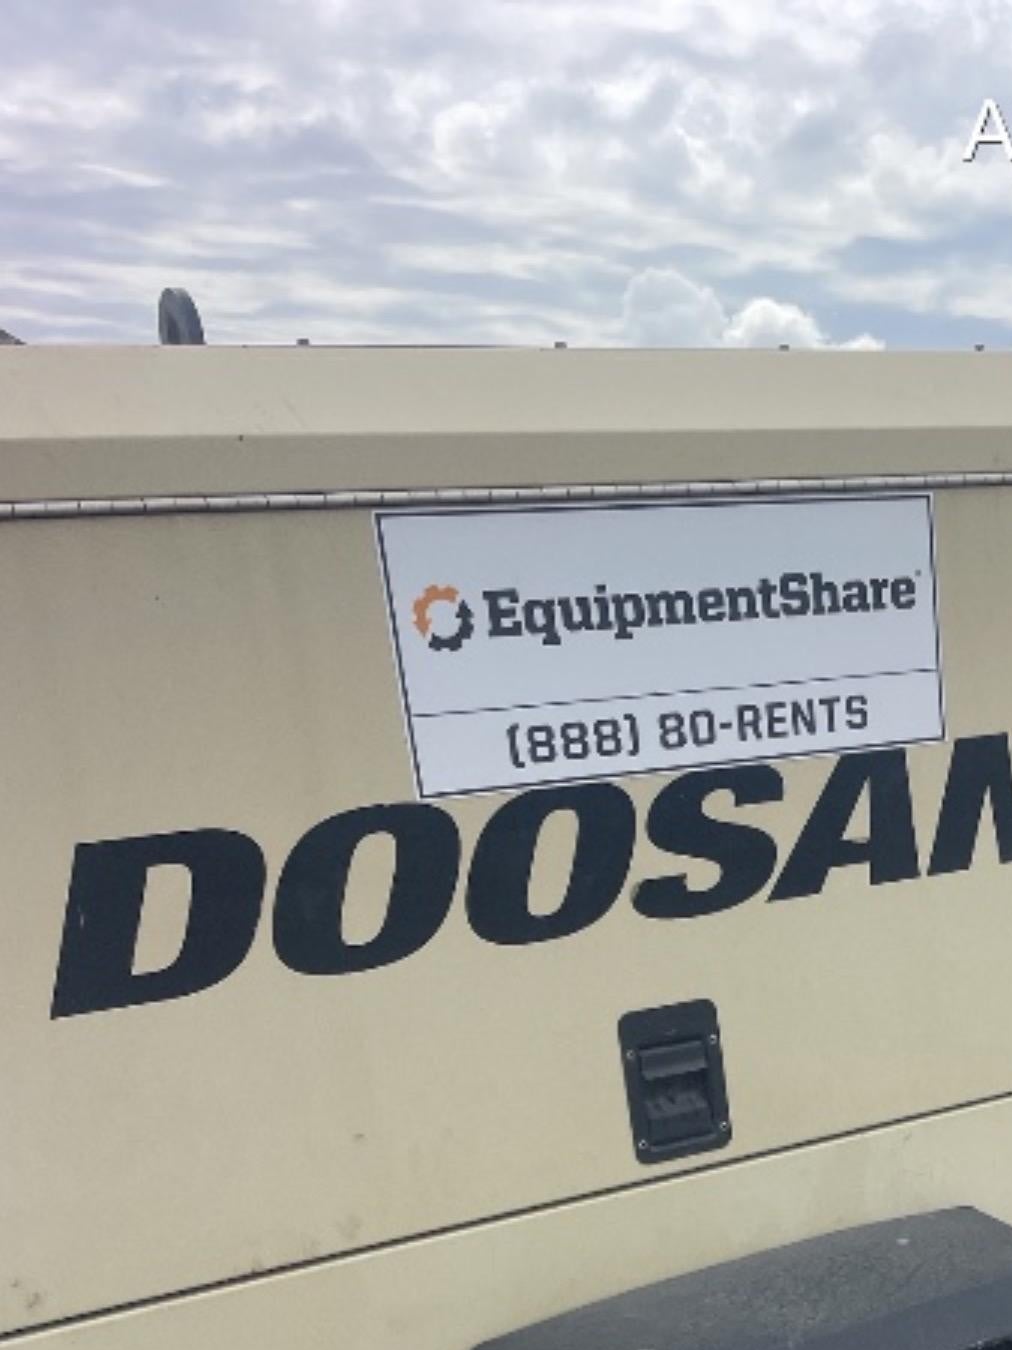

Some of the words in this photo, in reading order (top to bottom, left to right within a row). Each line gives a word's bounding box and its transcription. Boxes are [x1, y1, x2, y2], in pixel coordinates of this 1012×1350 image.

[482, 571, 918, 646] EquipmentShare
[506, 713, 641, 769] (888)
[657, 695, 870, 750] 80-RENTS
